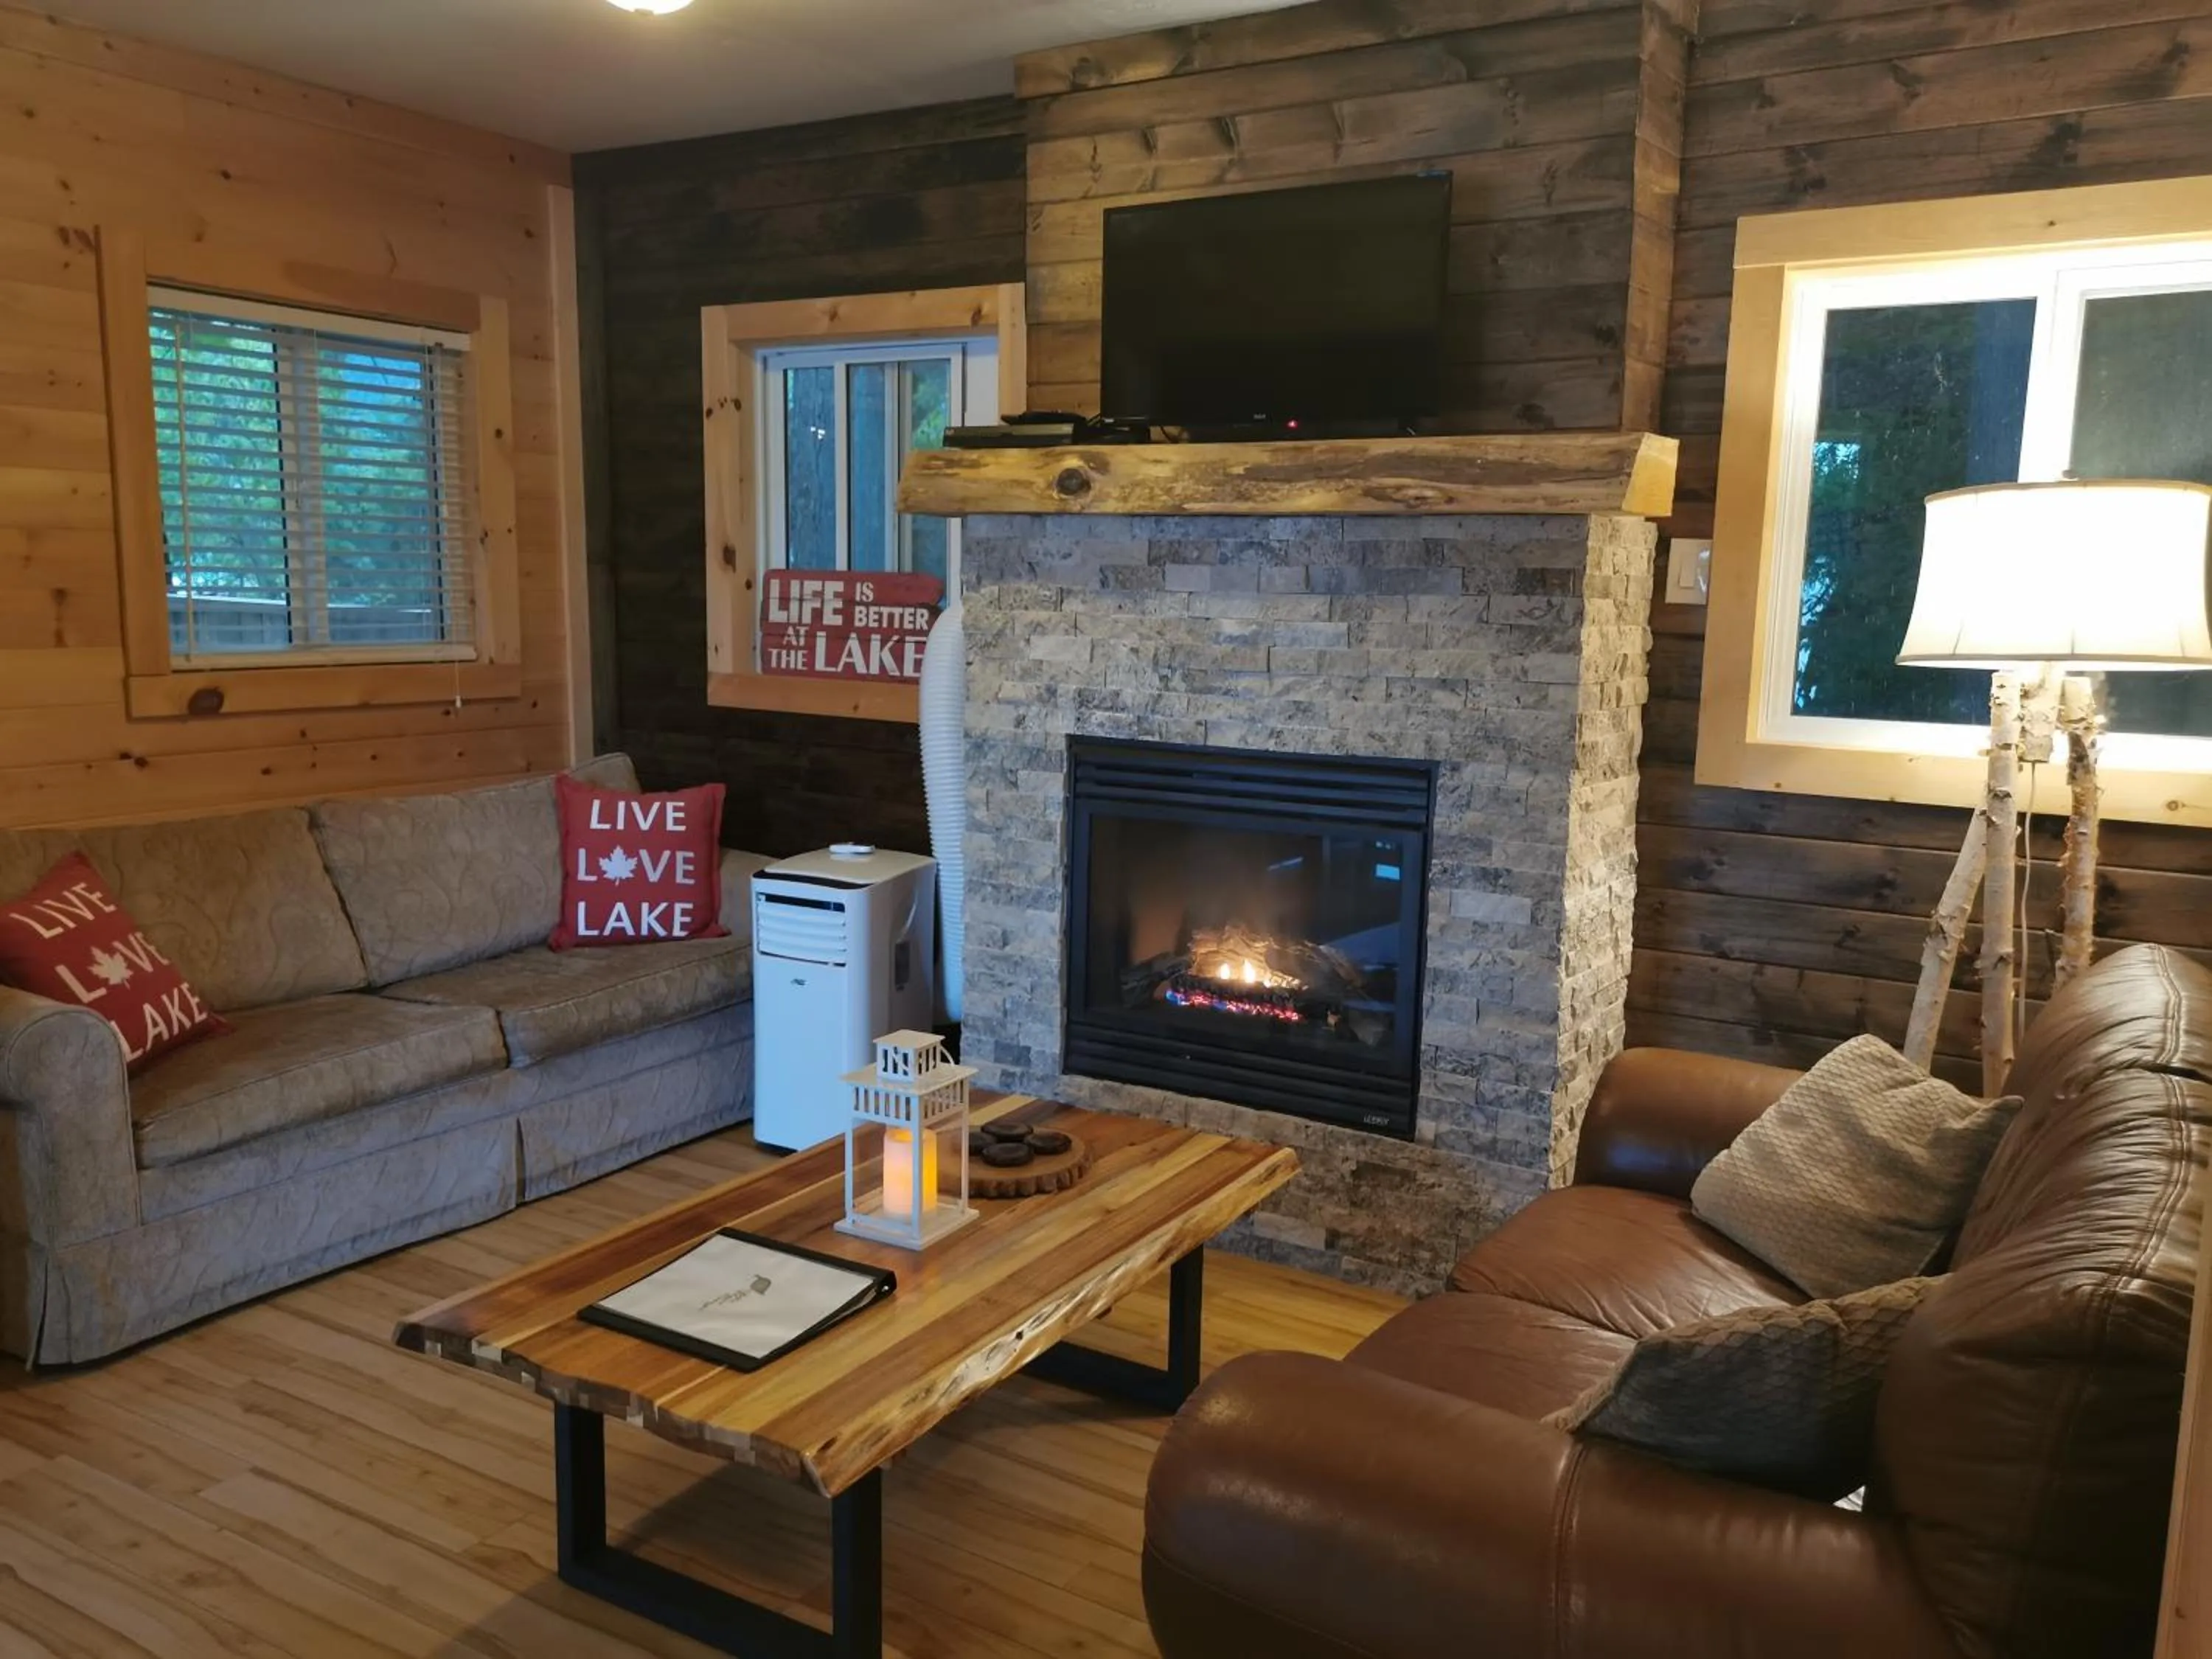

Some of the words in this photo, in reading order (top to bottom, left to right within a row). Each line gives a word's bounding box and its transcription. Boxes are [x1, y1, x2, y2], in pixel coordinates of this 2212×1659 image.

[768, 579, 844, 625] LIFE
[855, 582, 874, 602] IS
[854, 605, 929, 630] BETTER
[768, 648, 808, 670] THE
[815, 630, 928, 678] LAKE
[782, 626, 809, 647] AT
[590, 799, 686, 832] LIVE
[577, 845, 695, 886] LVE
[9, 883, 117, 939] LIVE
[577, 901, 694, 937] LAKE
[55, 931, 170, 1004] LVE
[110, 982, 208, 1062] LAKE
